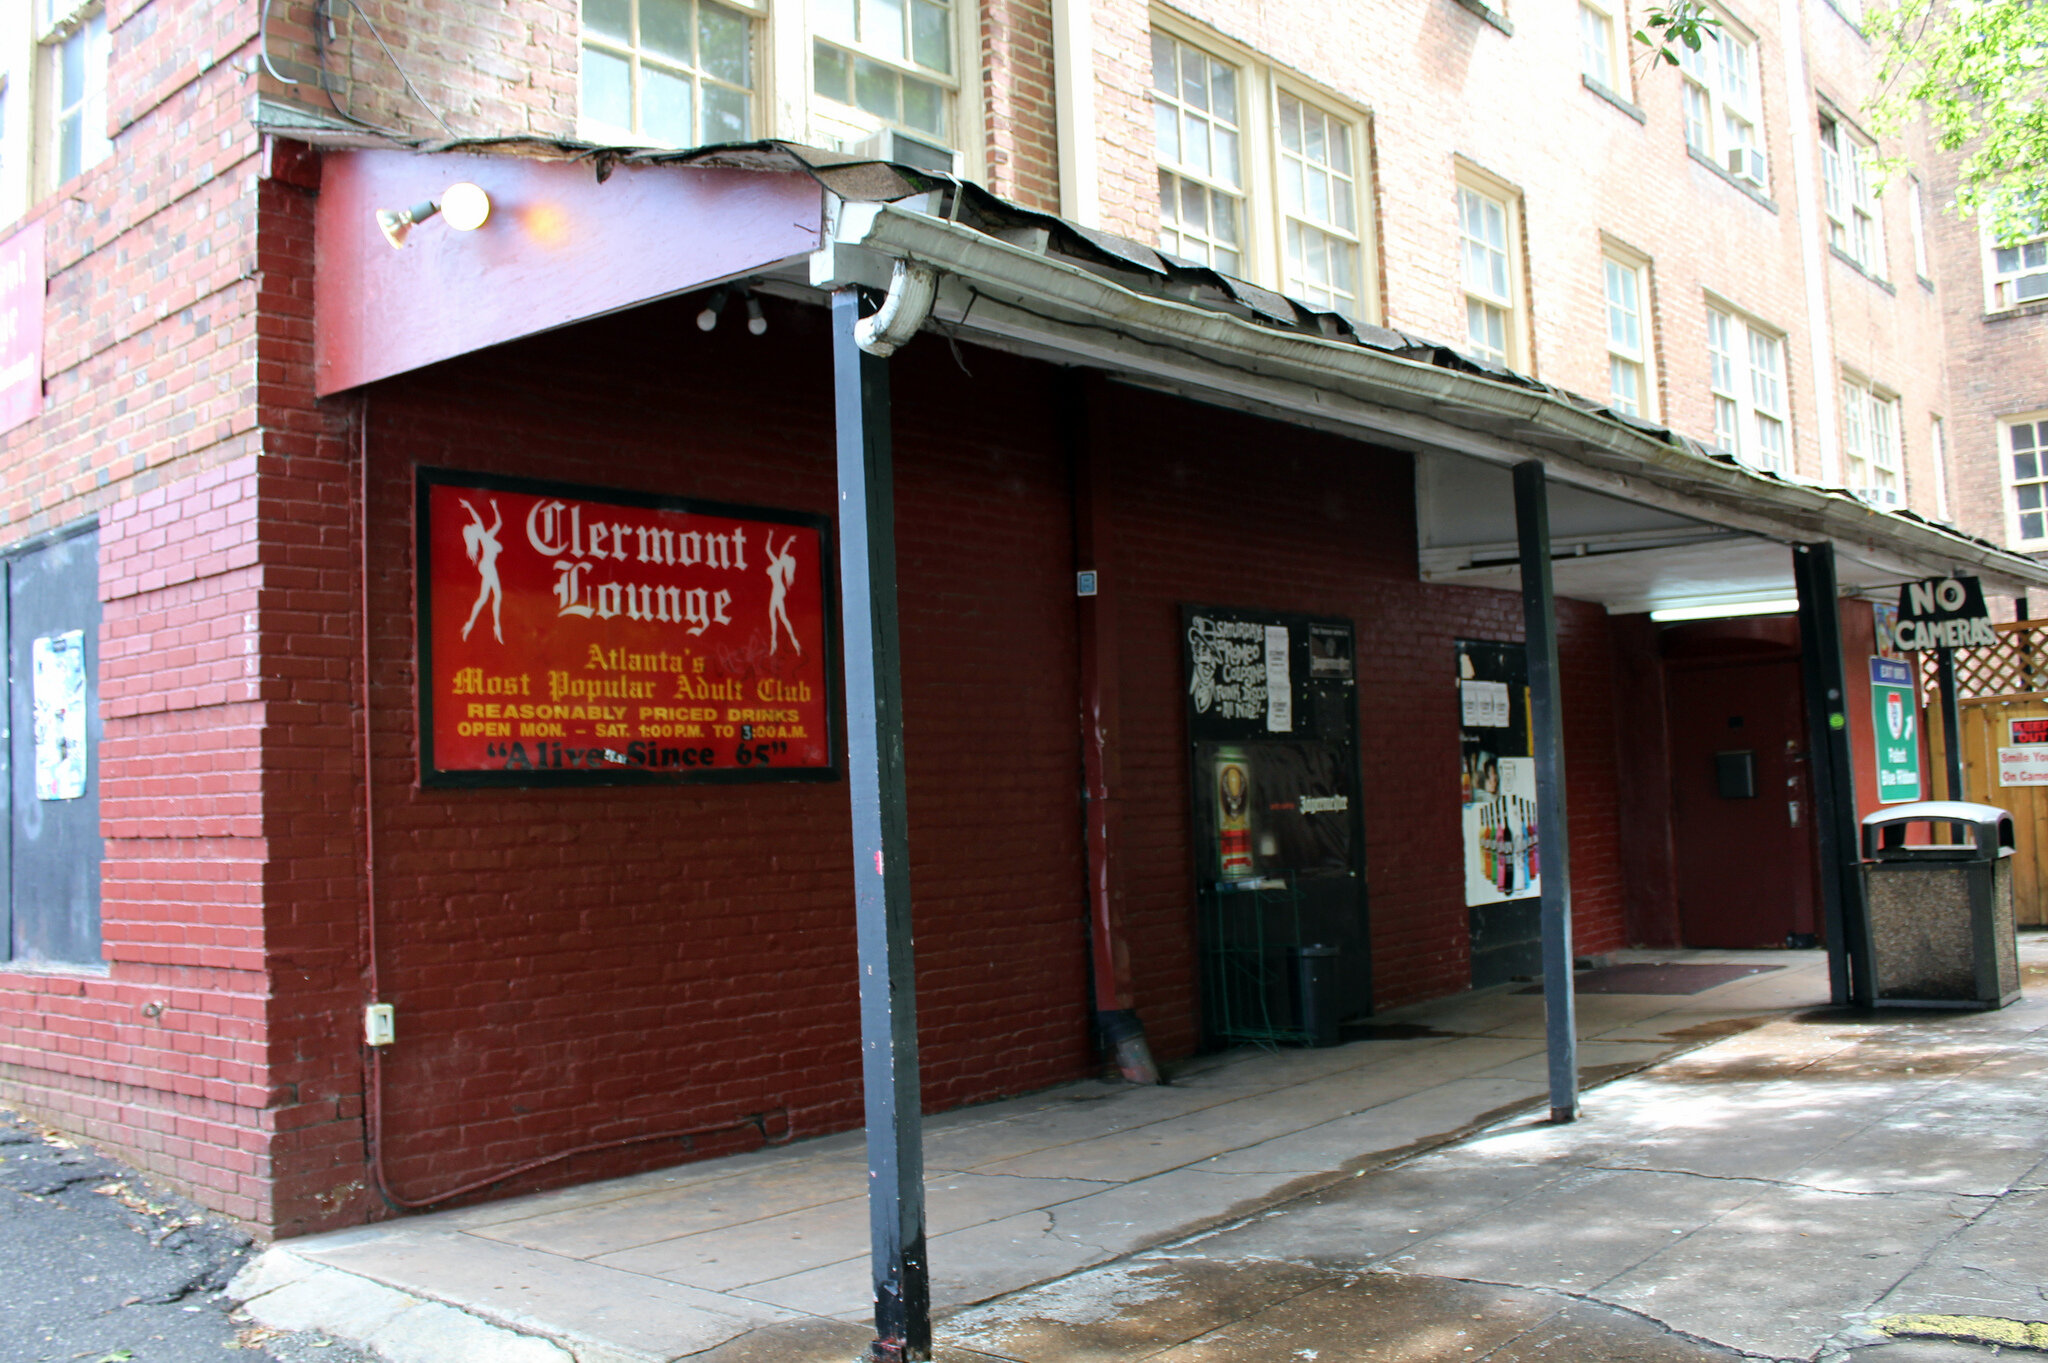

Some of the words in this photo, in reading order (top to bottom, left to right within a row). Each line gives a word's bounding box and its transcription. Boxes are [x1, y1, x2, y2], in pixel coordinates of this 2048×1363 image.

[526, 499, 749, 571] Clermont
[553, 560, 732, 636] Lounge
[1909, 579, 1966, 616] NO
[1895, 617, 1998, 651] CAMERAS
[584, 643, 705, 674] Atlanta's
[452, 666, 531, 696] Most
[548, 669, 657, 703] Popular
[674, 674, 743, 701] Adult
[757, 677, 811, 703] Club
[467, 703, 627, 720] REASONABLY
[639, 707, 718, 722] PRICED
[728, 708, 799, 723] DRINKS
[457, 721, 511, 737] OPEN
[520, 722, 567, 737] MON.
[596, 723, 631, 738] SAT.
[713, 725, 734, 738] TO
[2018, 732, 2047, 743] OUT
[626, 740, 715, 767] Since
[2001, 752, 2029, 763] Smile
[2003, 771, 2016, 781] On
